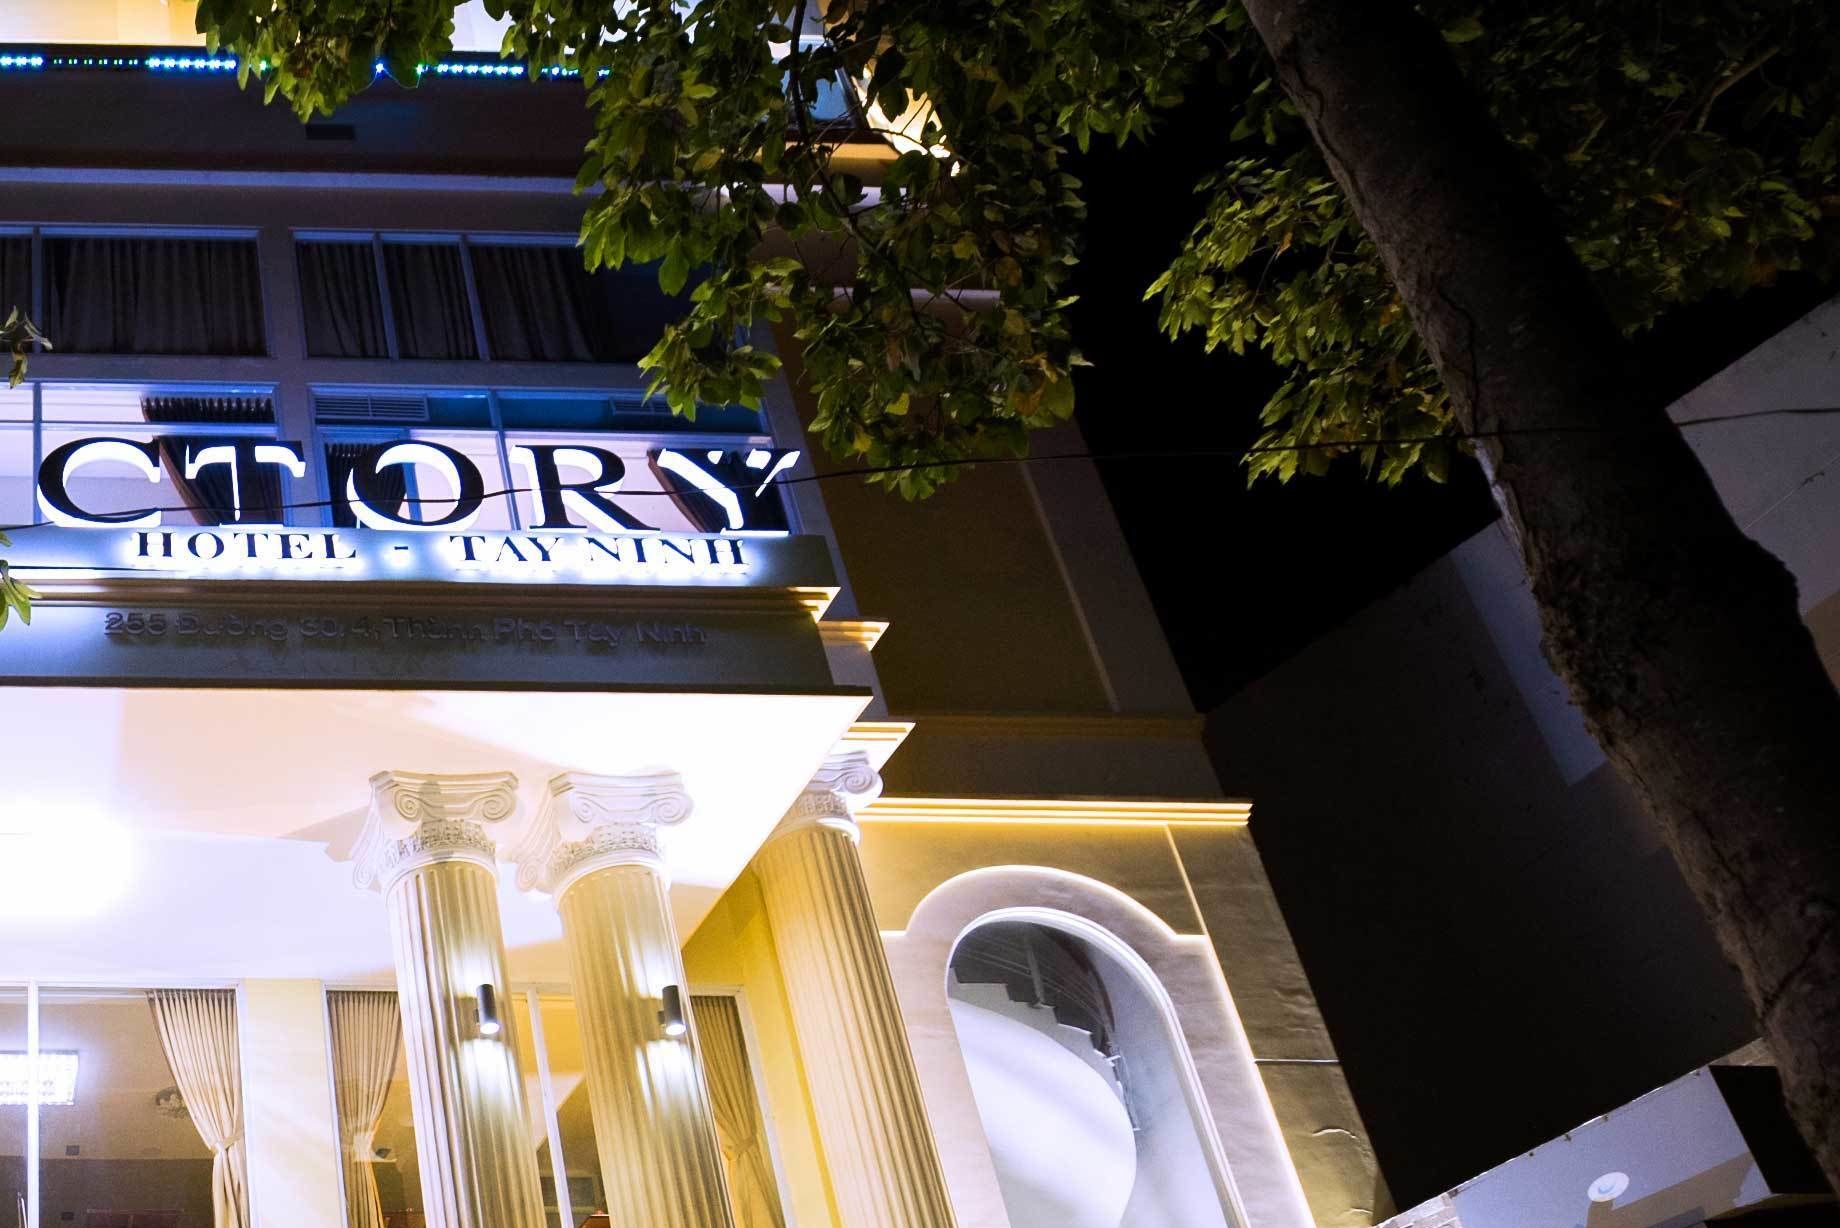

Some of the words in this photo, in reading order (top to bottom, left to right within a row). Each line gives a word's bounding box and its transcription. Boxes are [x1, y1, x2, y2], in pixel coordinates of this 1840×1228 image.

[135, 531, 358, 560] HOTEL
[450, 535, 561, 562] TAY
[584, 536, 749, 565] NINH
[103, 611, 167, 637] 255
[635, 619, 707, 644] Ninh
